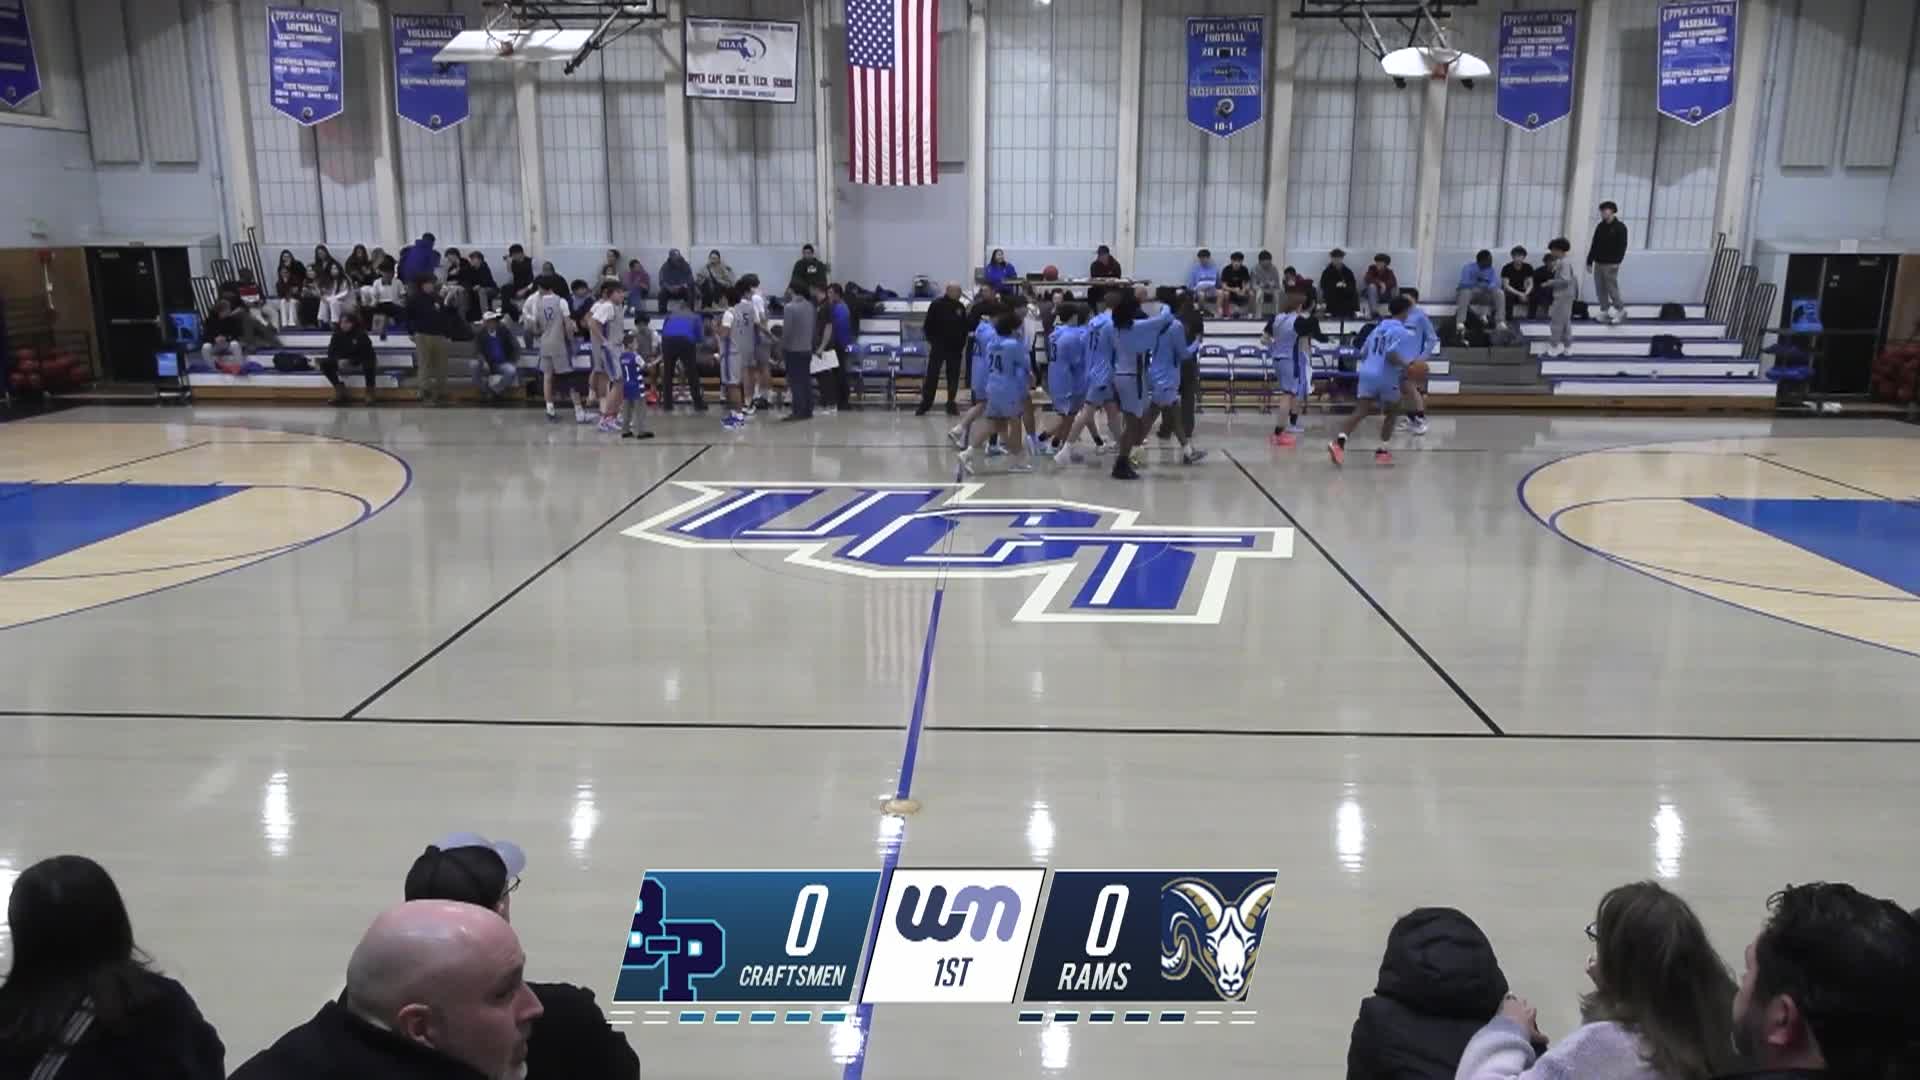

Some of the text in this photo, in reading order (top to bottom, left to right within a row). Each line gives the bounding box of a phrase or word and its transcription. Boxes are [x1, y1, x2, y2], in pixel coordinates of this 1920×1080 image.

[286, 22, 323, 33] SOFTBALL
[1679, 17, 1717, 29] BASEBALL
[1205, 33, 1245, 42] FOOTBALL
[1215, 122, 1233, 131] 10-1
[620, 481, 1293, 623] UCT
